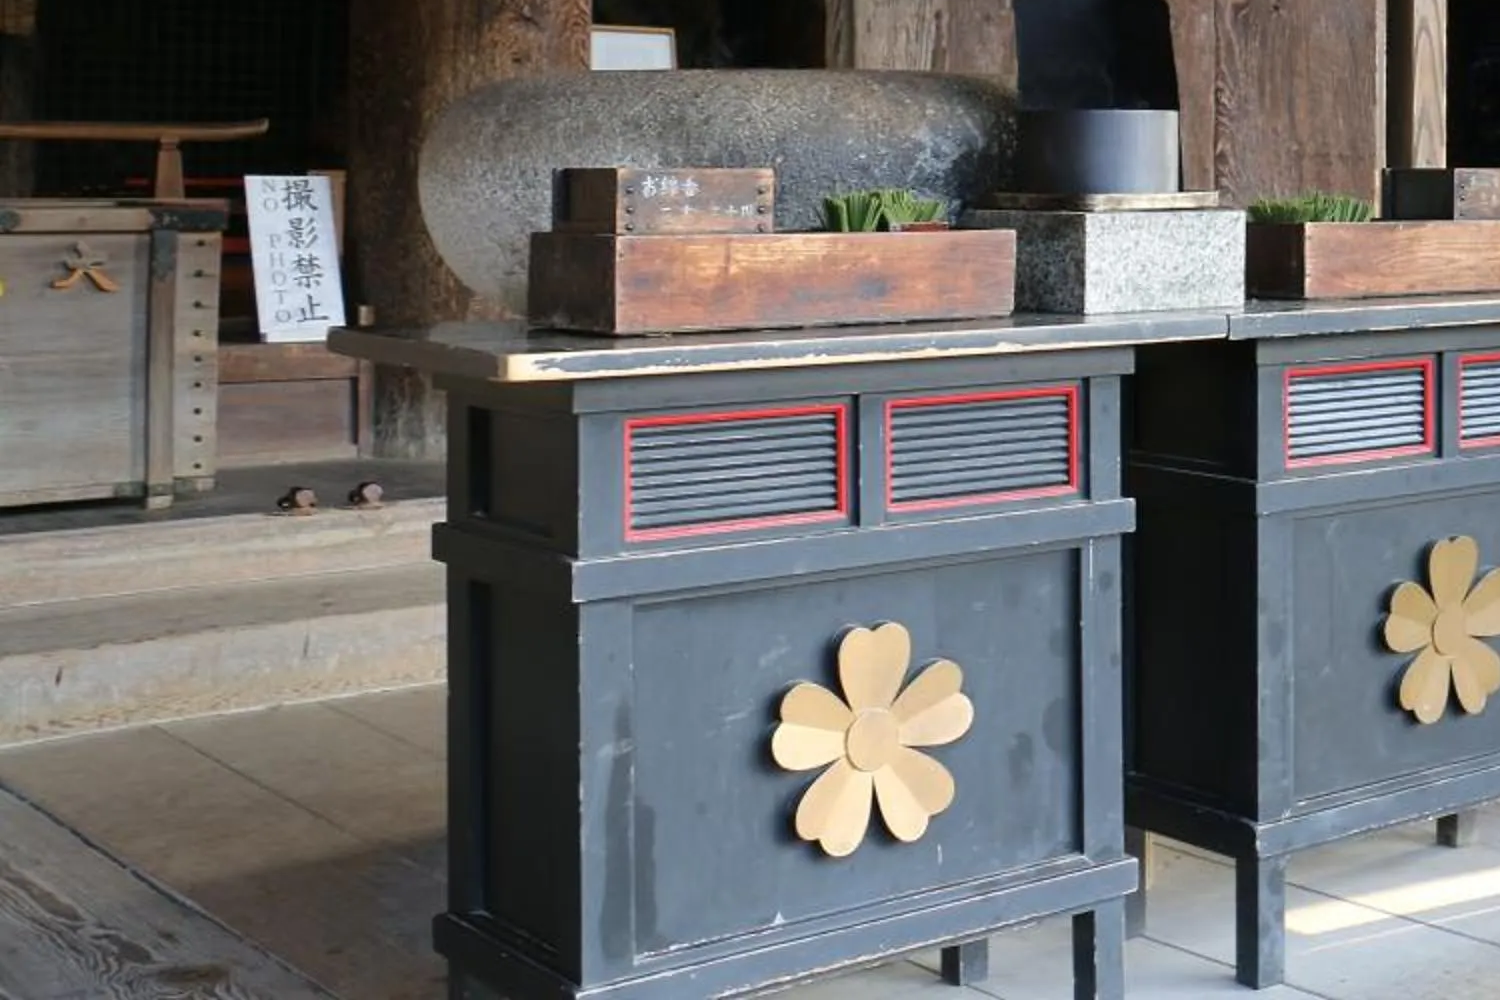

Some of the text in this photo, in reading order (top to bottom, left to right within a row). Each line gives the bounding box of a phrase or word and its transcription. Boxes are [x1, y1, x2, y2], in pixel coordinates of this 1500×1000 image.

[261, 179, 292, 324] NO PHOTO
[280, 179, 329, 324] 撮影禁止
